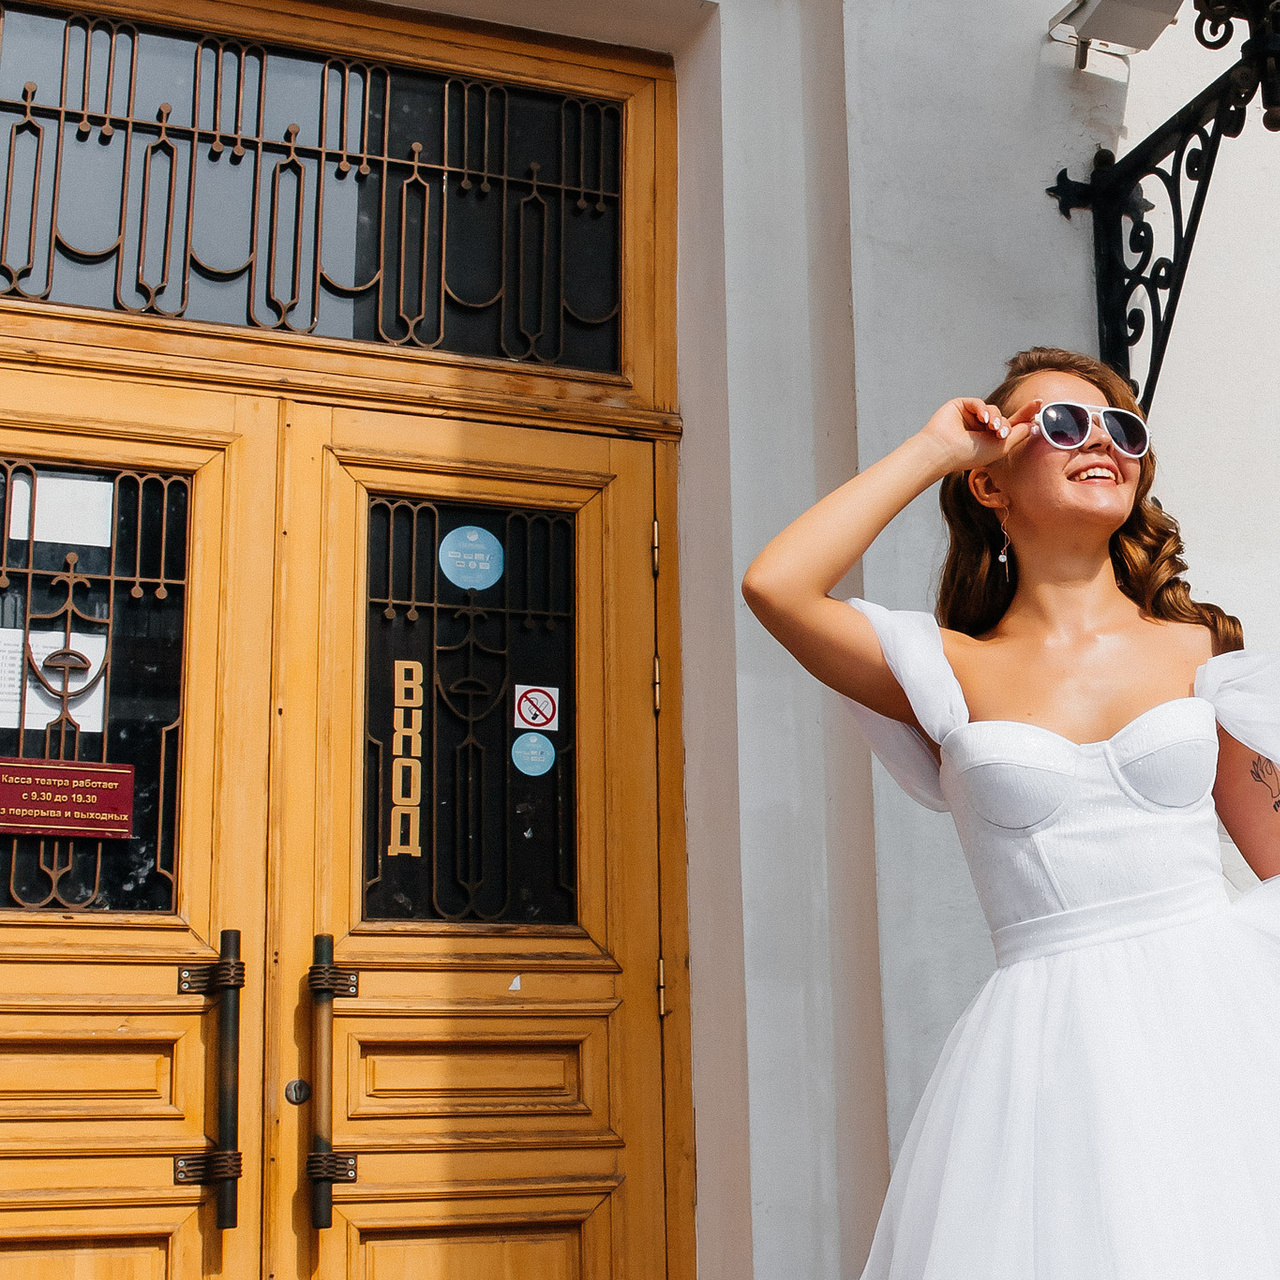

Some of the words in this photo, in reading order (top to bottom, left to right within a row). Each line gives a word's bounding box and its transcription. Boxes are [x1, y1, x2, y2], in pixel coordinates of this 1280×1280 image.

[387, 659, 424, 857] ВХОД
[1, 774, 32, 784] Касса
[34, 777, 70, 787] театра
[72, 779, 119, 789] работает
[22, 792, 28, 800] с
[31, 791, 52, 801] 9.30
[54, 794, 68, 803] до
[71, 793, 98, 804] 19.30
[8, 808, 62, 818] перерыва
[74, 811, 129, 821] выходных
